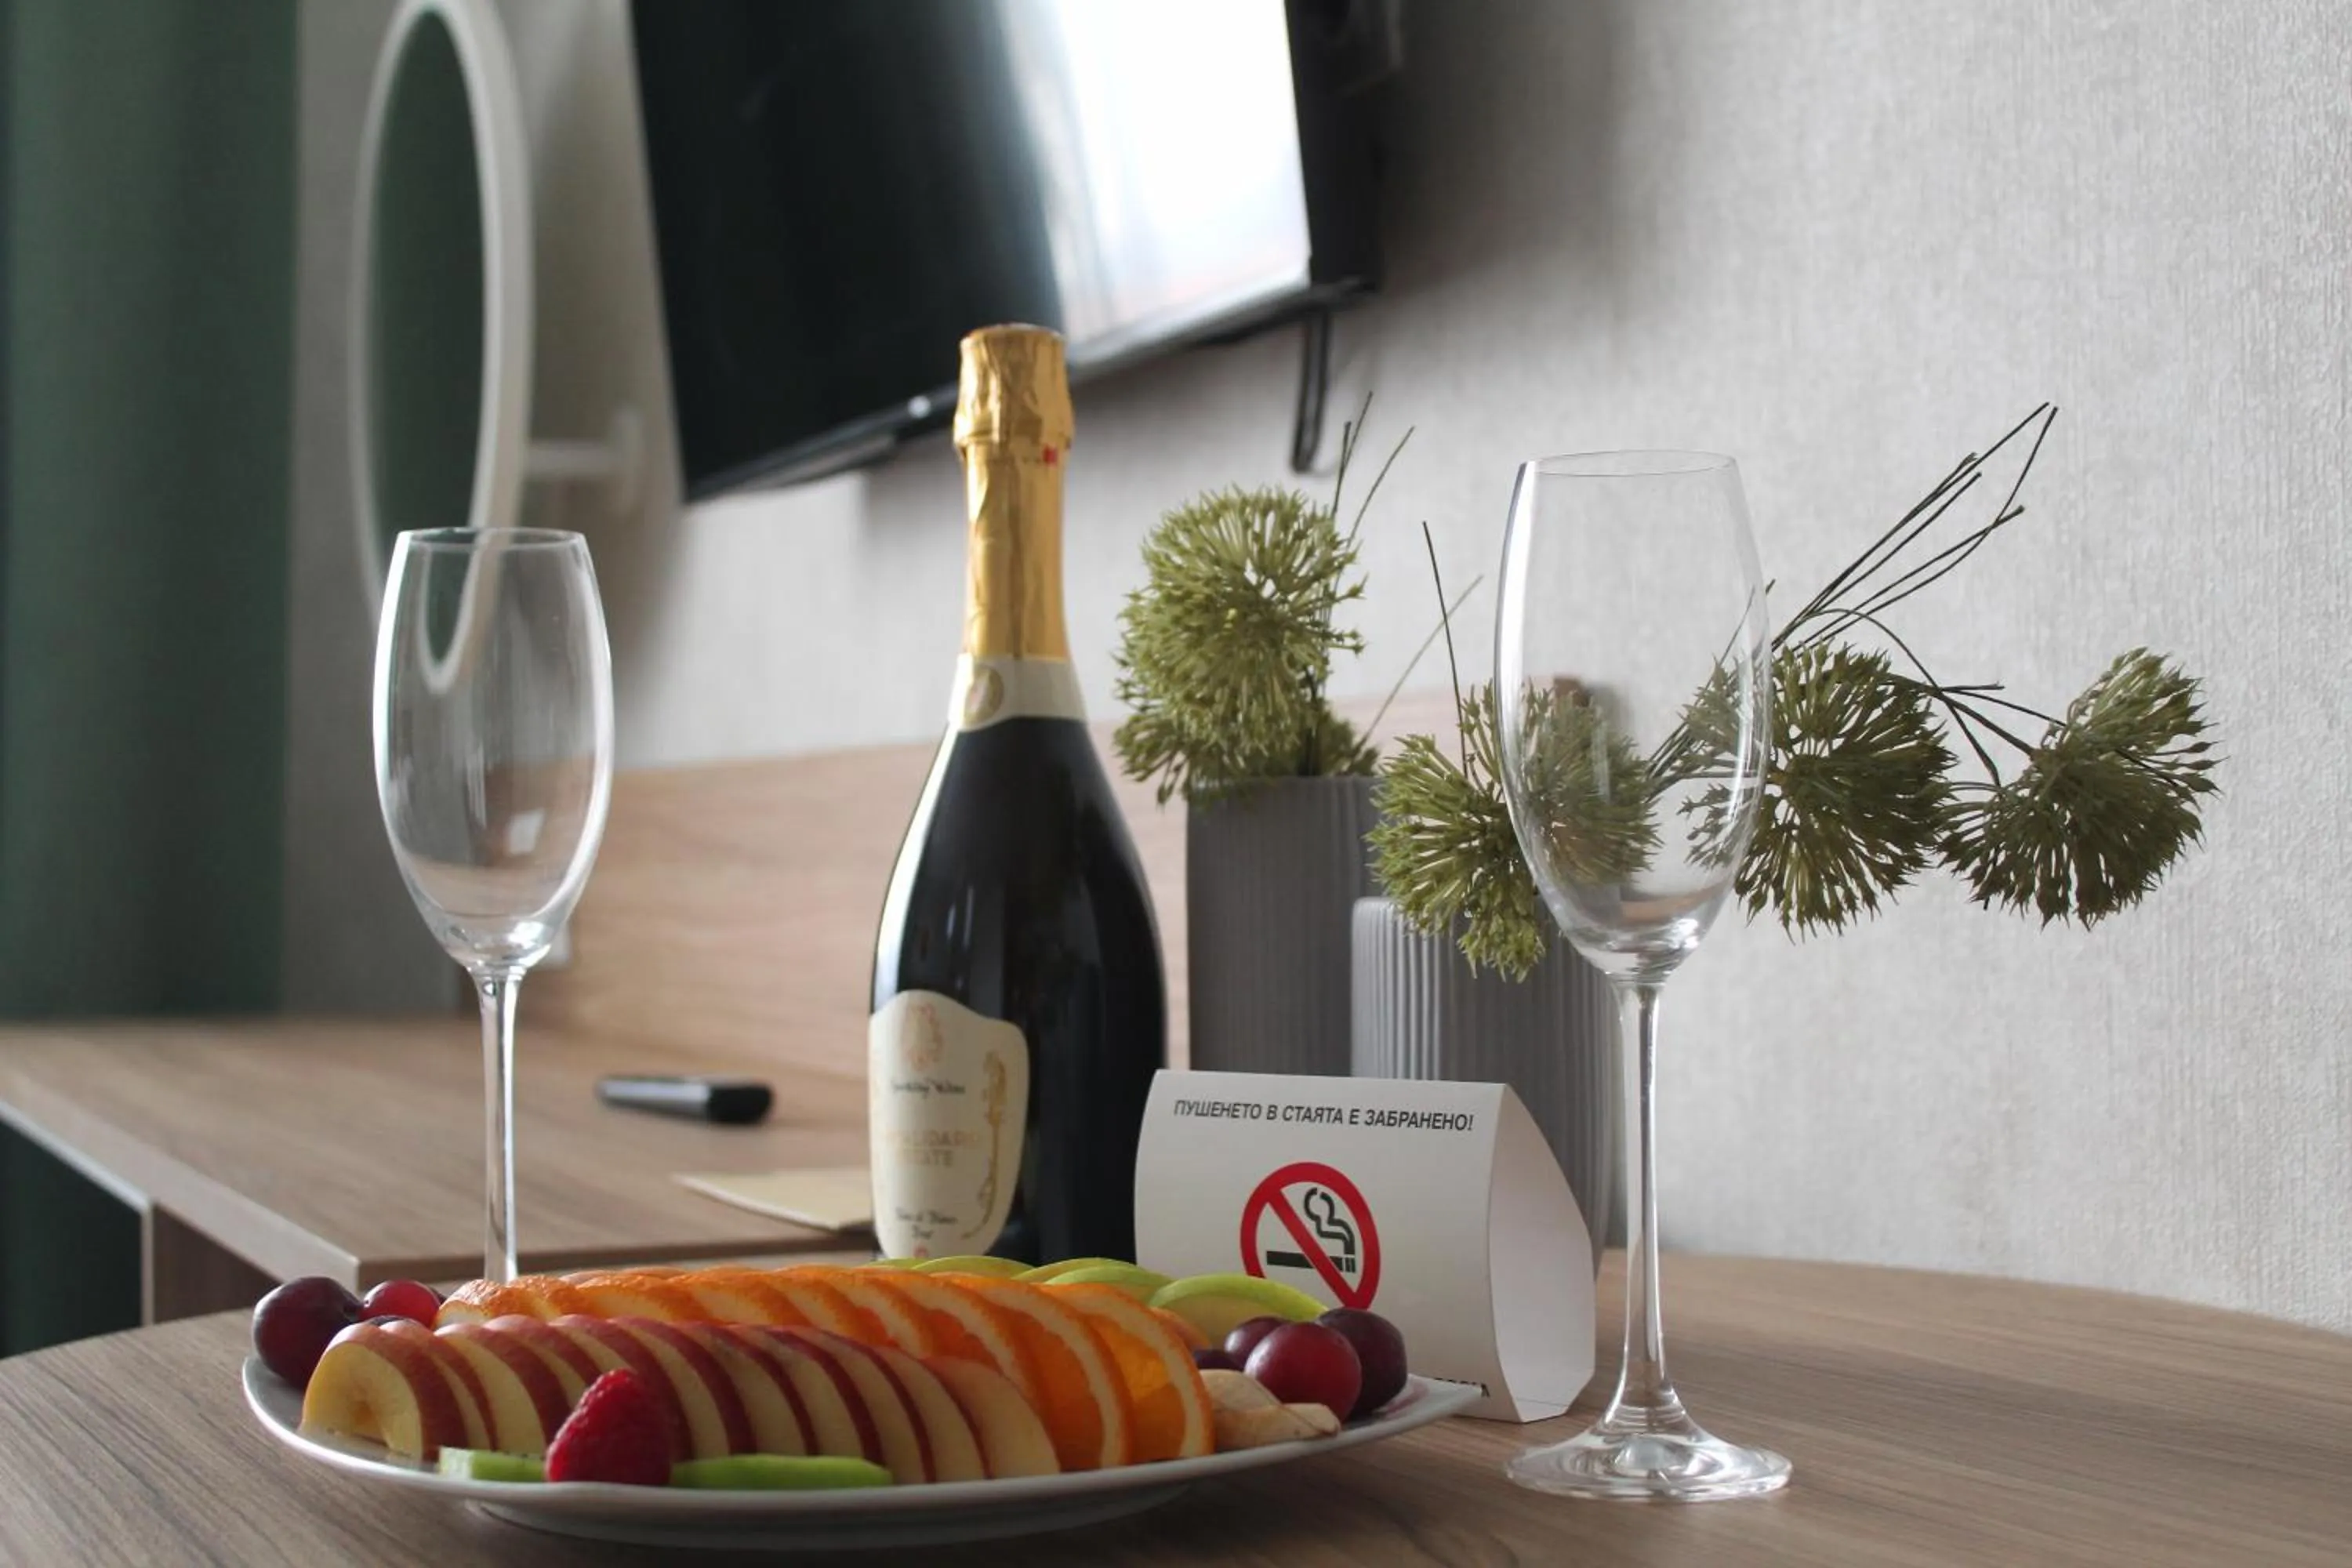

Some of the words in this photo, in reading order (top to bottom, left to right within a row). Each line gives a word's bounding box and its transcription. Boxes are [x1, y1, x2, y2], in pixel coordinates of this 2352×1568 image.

[1174, 1099, 1261, 1120] ПУШЕНЕТО
[1266, 1104, 1279, 1121] В
[1282, 1105, 1344, 1125] СТАЯТА
[1348, 1109, 1361, 1125] Е
[1364, 1109, 1474, 1131] ЗАБРАНЕНО!
